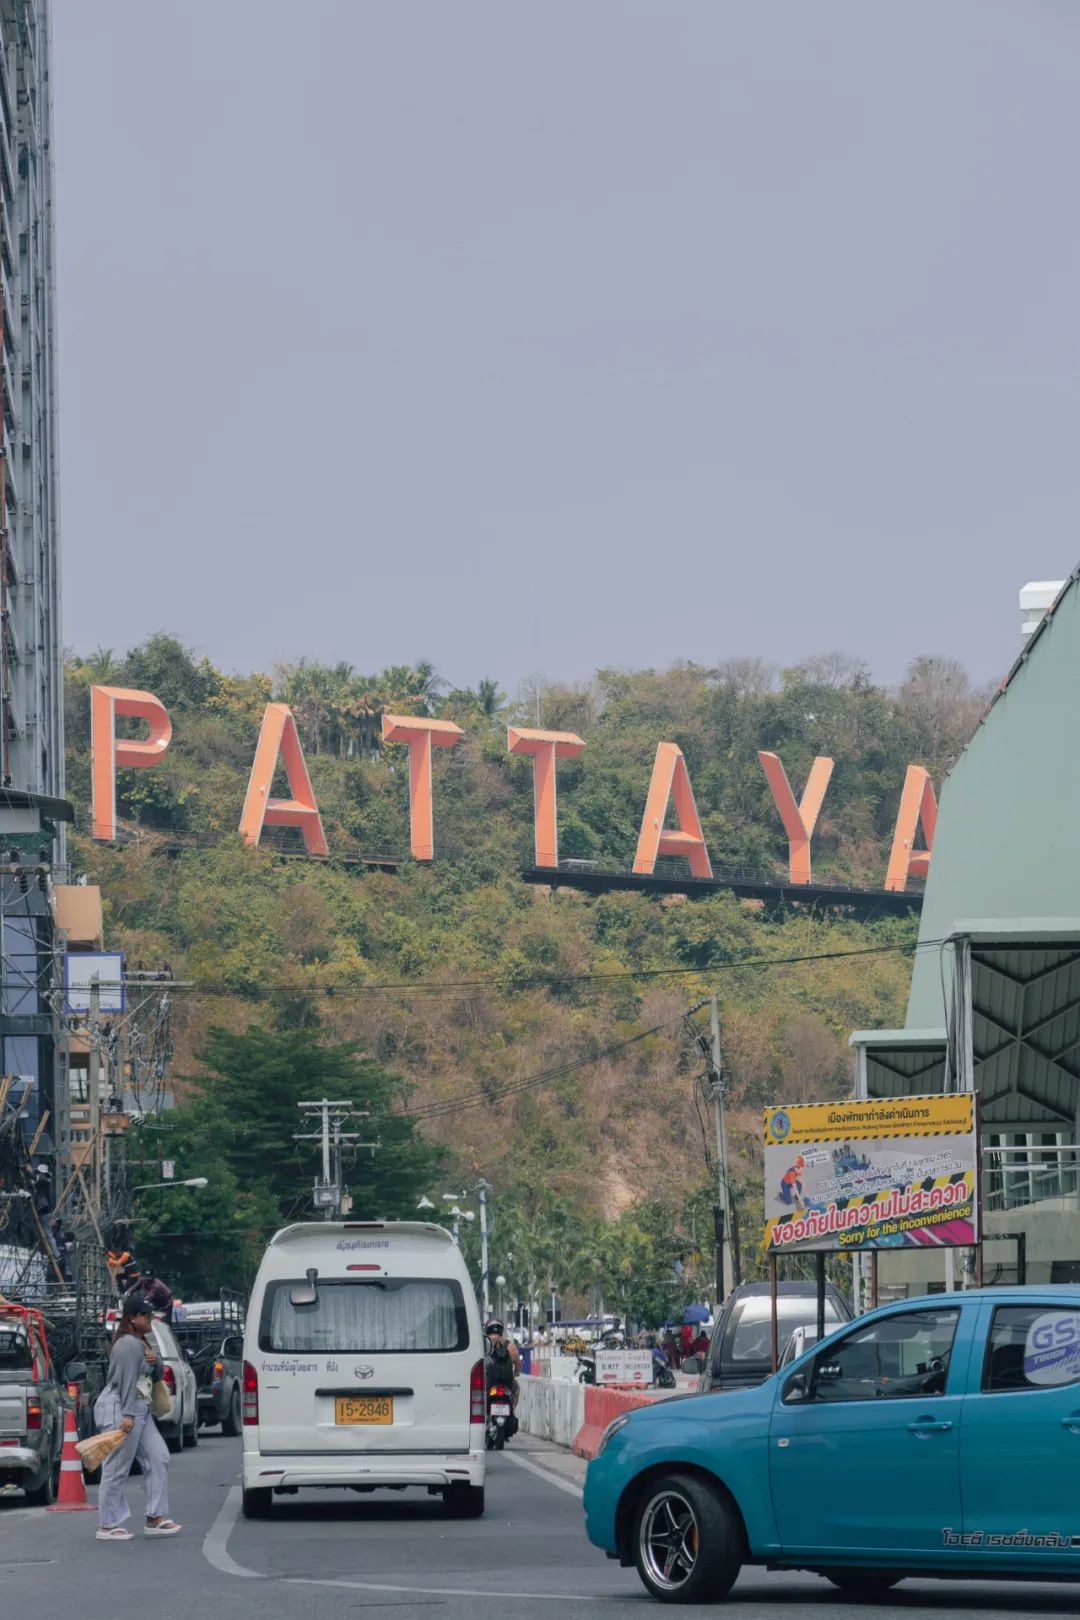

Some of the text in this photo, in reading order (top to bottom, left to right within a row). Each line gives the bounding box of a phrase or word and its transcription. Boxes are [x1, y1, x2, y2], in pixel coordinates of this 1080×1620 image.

[90, 685, 938, 892] PATTAYA
[828, 1108, 930, 1124] เมืองพัทยากำลังดำเนินการ
[772, 1182, 968, 1245] ขออภัยในความไม่สะดวก
[838, 1206, 972, 1246] Sorry for the inconvenience
[1032, 1317, 1076, 1350] GS
[340, 1402, 390, 1417] 15-2946
